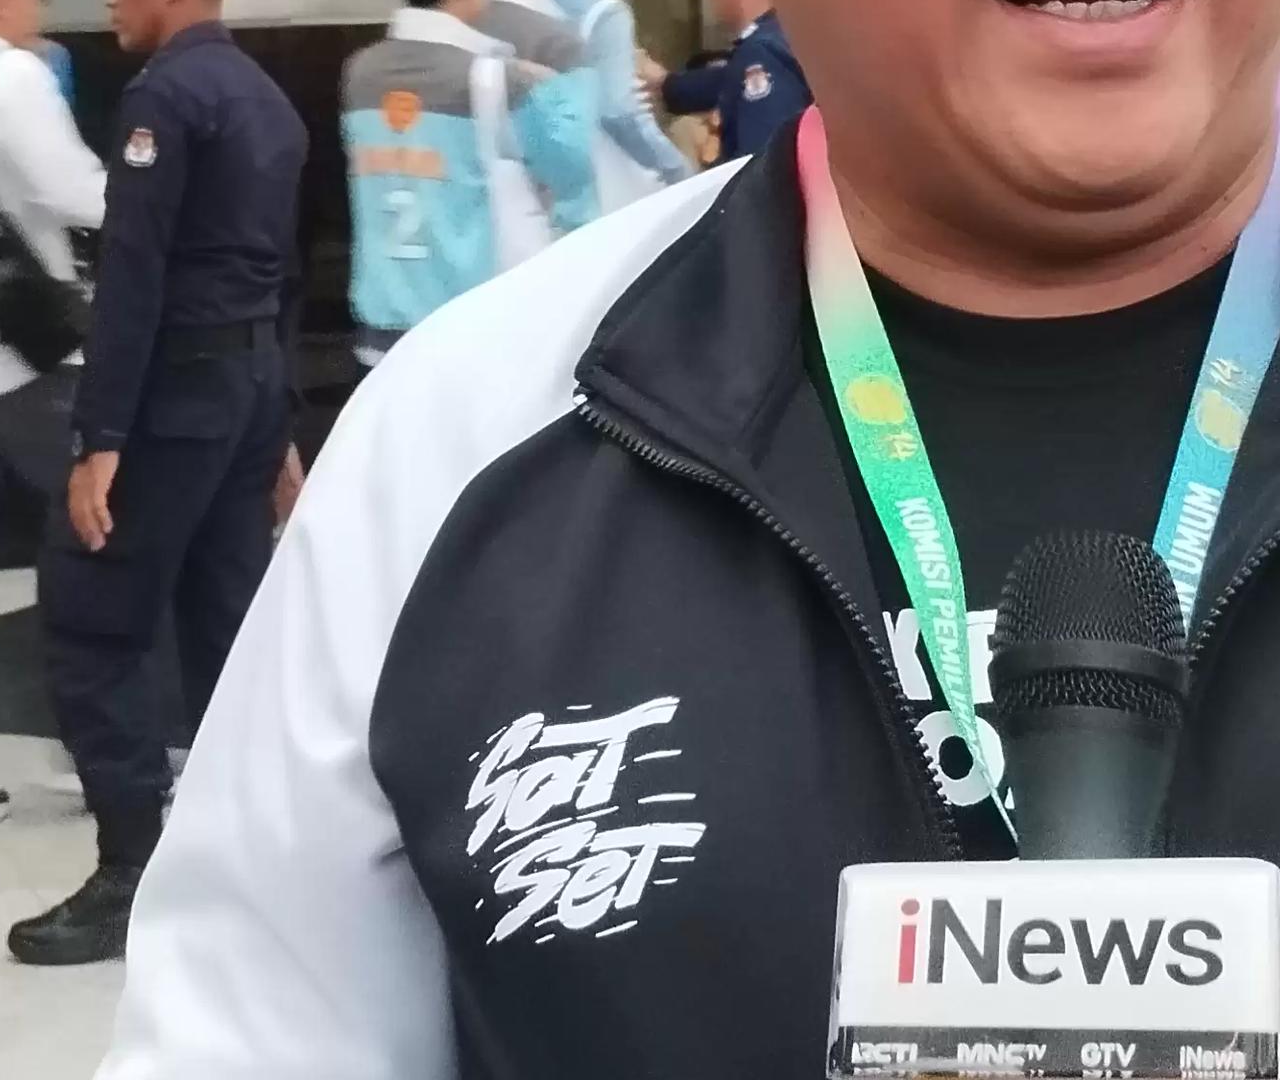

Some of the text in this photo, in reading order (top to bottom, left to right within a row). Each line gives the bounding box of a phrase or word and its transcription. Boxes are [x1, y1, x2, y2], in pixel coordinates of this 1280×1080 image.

[894, 496, 954, 592] KOMISI
[1169, 480, 1221, 576] UMUM
[897, 897, 1224, 987] iNews
[1080, 1042, 1136, 1068] GTV
